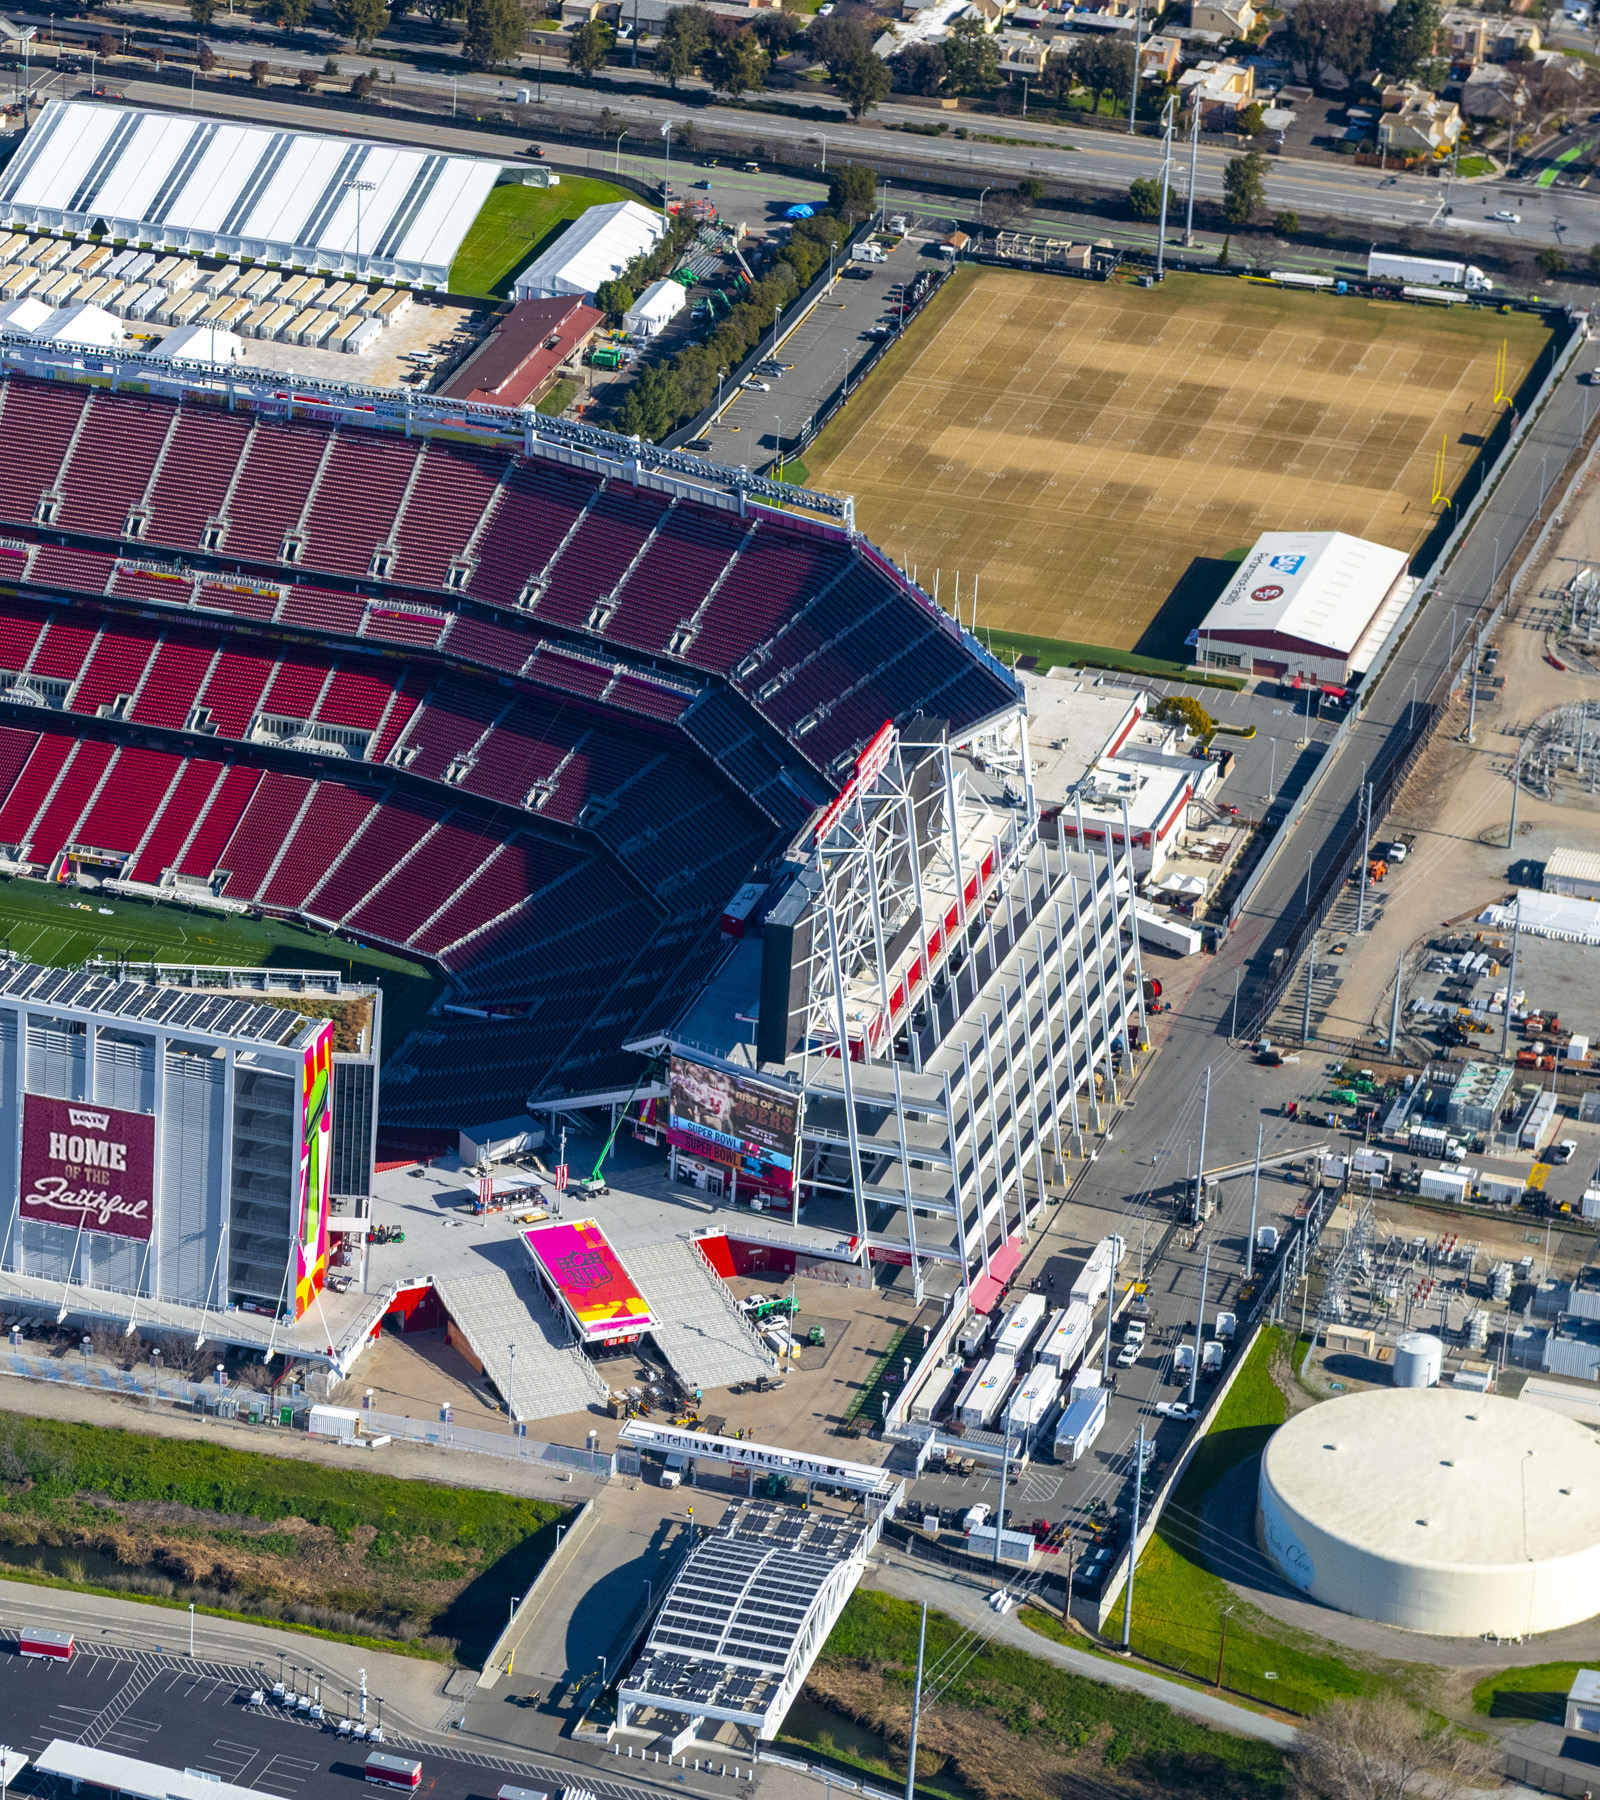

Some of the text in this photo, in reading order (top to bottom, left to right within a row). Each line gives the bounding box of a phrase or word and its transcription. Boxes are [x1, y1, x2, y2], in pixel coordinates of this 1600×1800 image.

[258, 401, 276, 412] BOWL
[314, 408, 333, 420] BOWL
[334, 411, 343, 422] LX
[735, 1091, 758, 1106] RISE
[760, 1099, 774, 1110] OF
[775, 1104, 795, 1117] THE
[735, 1100, 794, 1135] 49ERS
[687, 1122, 713, 1140] SUPER
[714, 1132, 738, 1149] BOWL
[49, 1132, 127, 1171] HOME
[685, 1136, 712, 1156] SUPER
[714, 1147, 738, 1166] BOWL
[65, 1164, 110, 1186] OF THE
[567, 1264, 609, 1285] NFL
[652, 1431, 845, 1477] DIGNITY HEALTH GATE C
